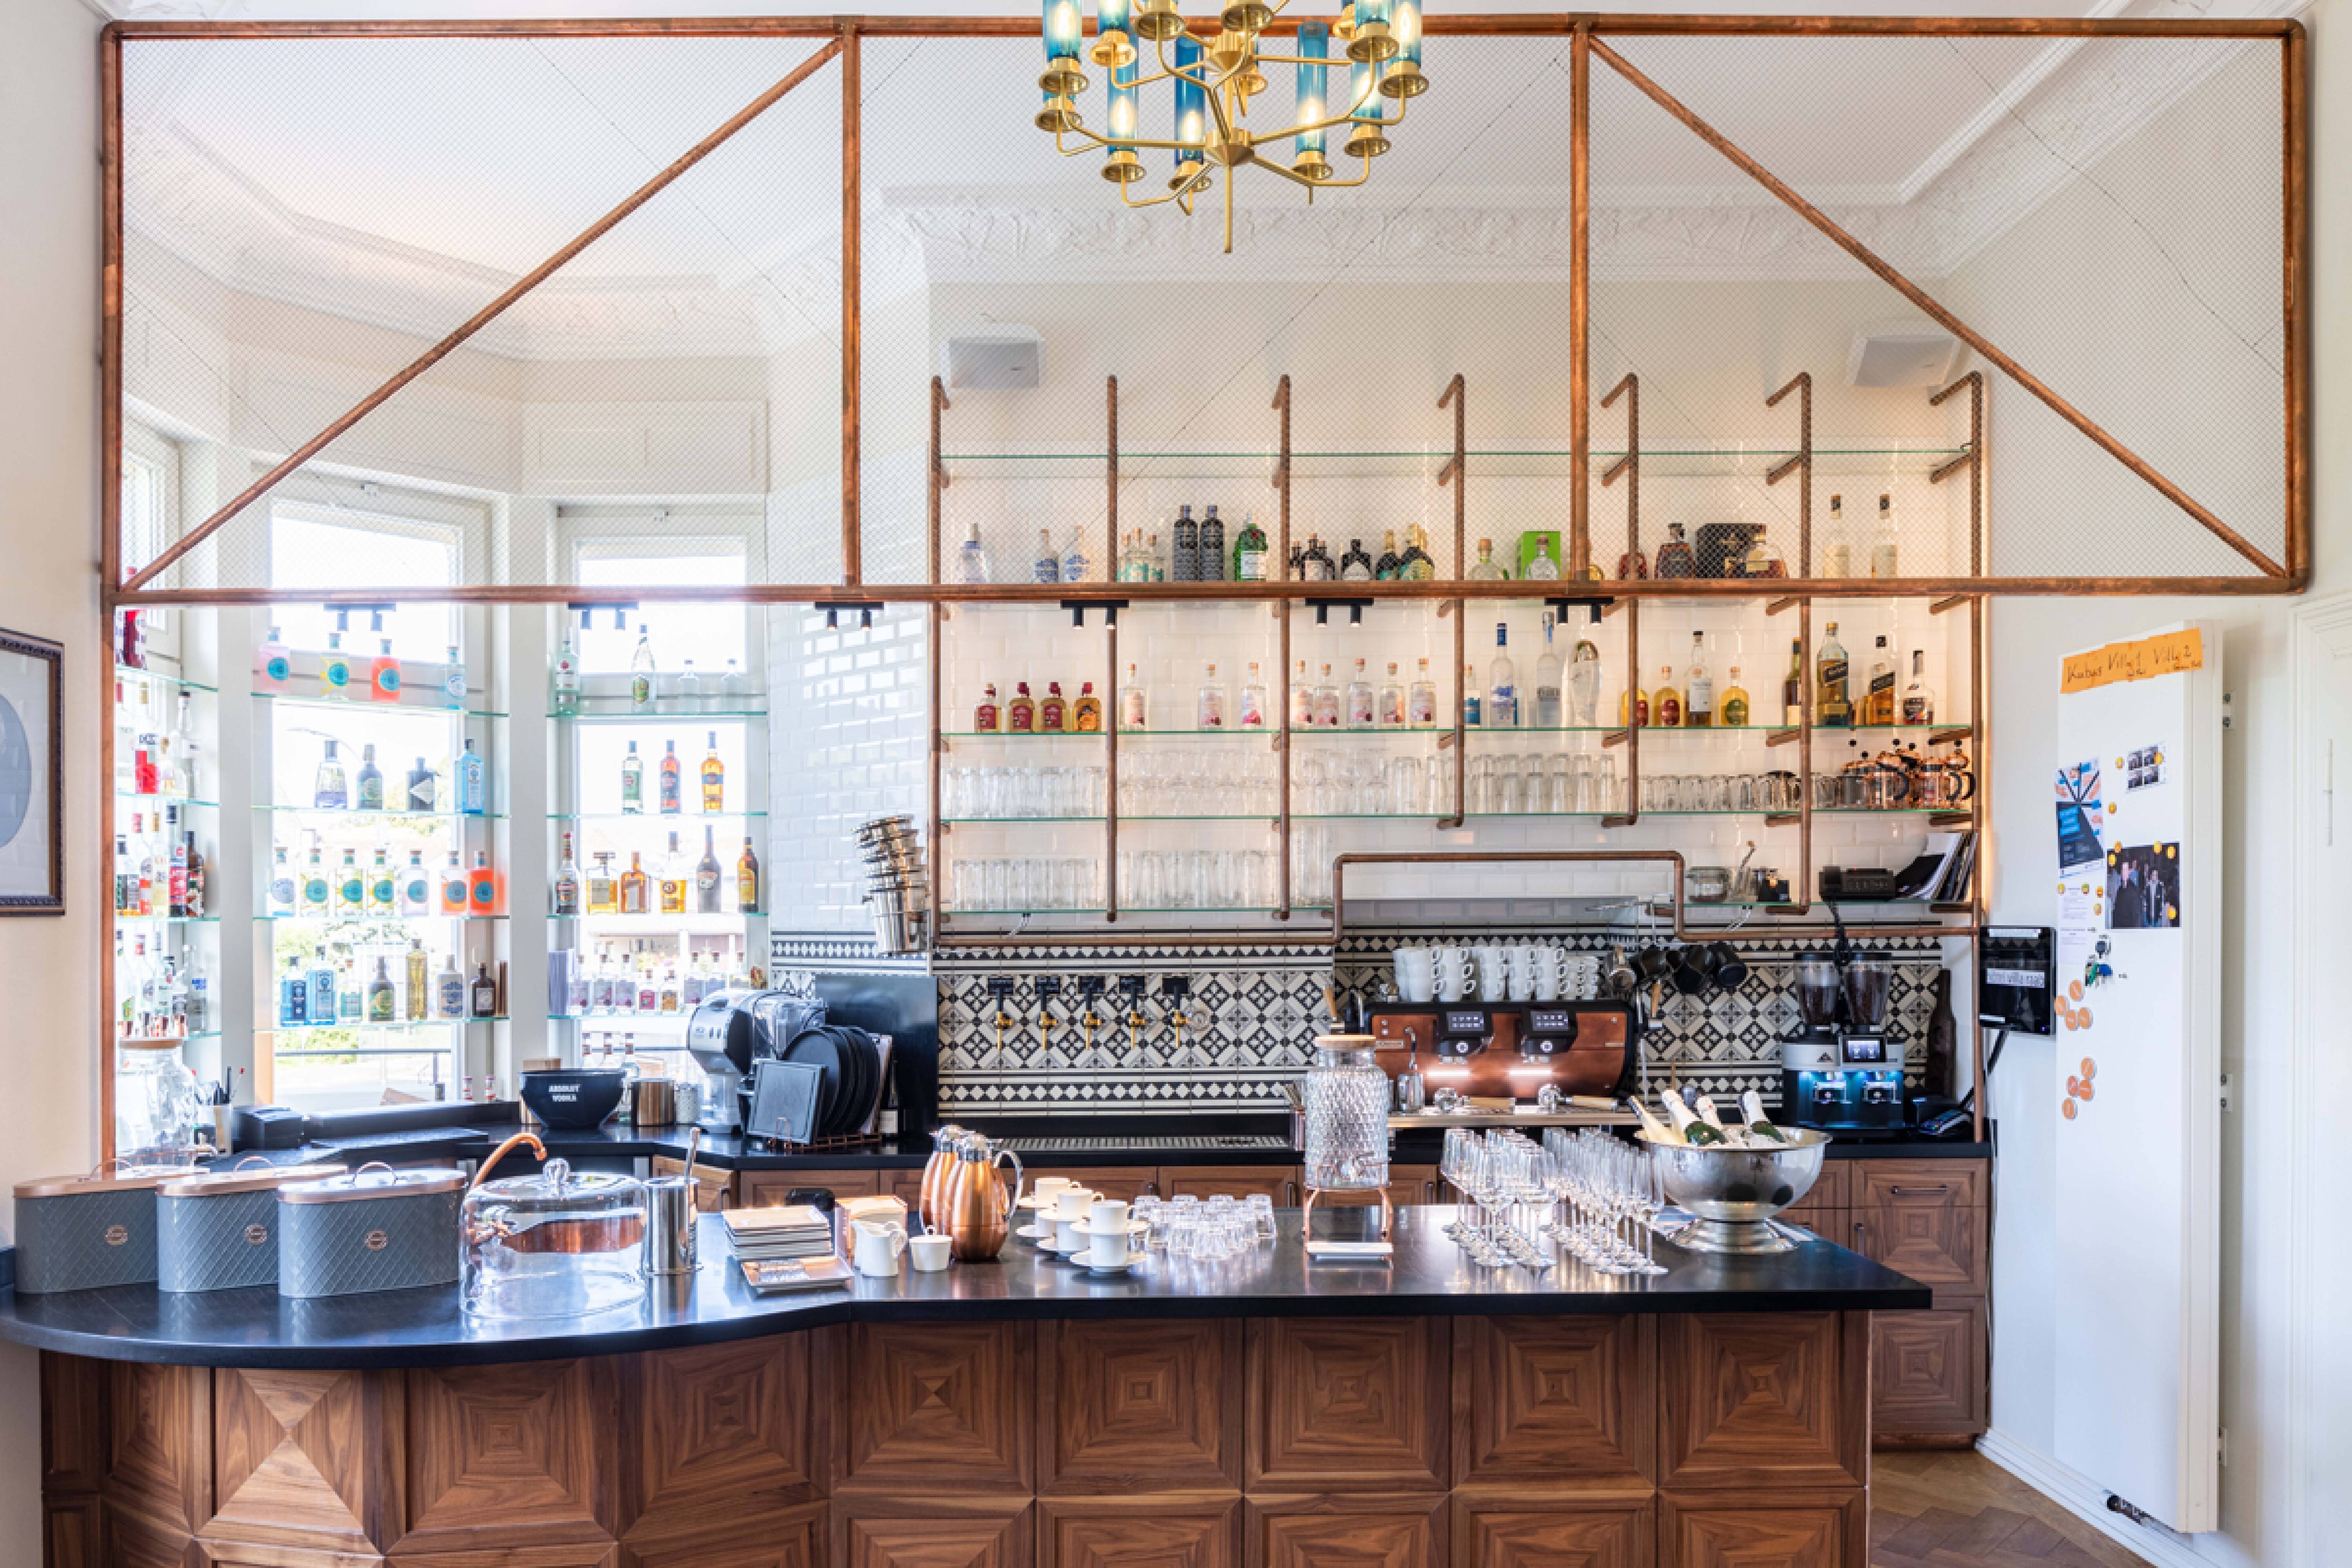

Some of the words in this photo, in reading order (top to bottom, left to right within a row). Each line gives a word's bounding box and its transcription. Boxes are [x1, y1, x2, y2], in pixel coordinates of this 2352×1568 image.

[2183, 644, 2192, 658] 2
[548, 1084, 581, 1092] ABSOLUT
[552, 1093, 577, 1102] VODKA
